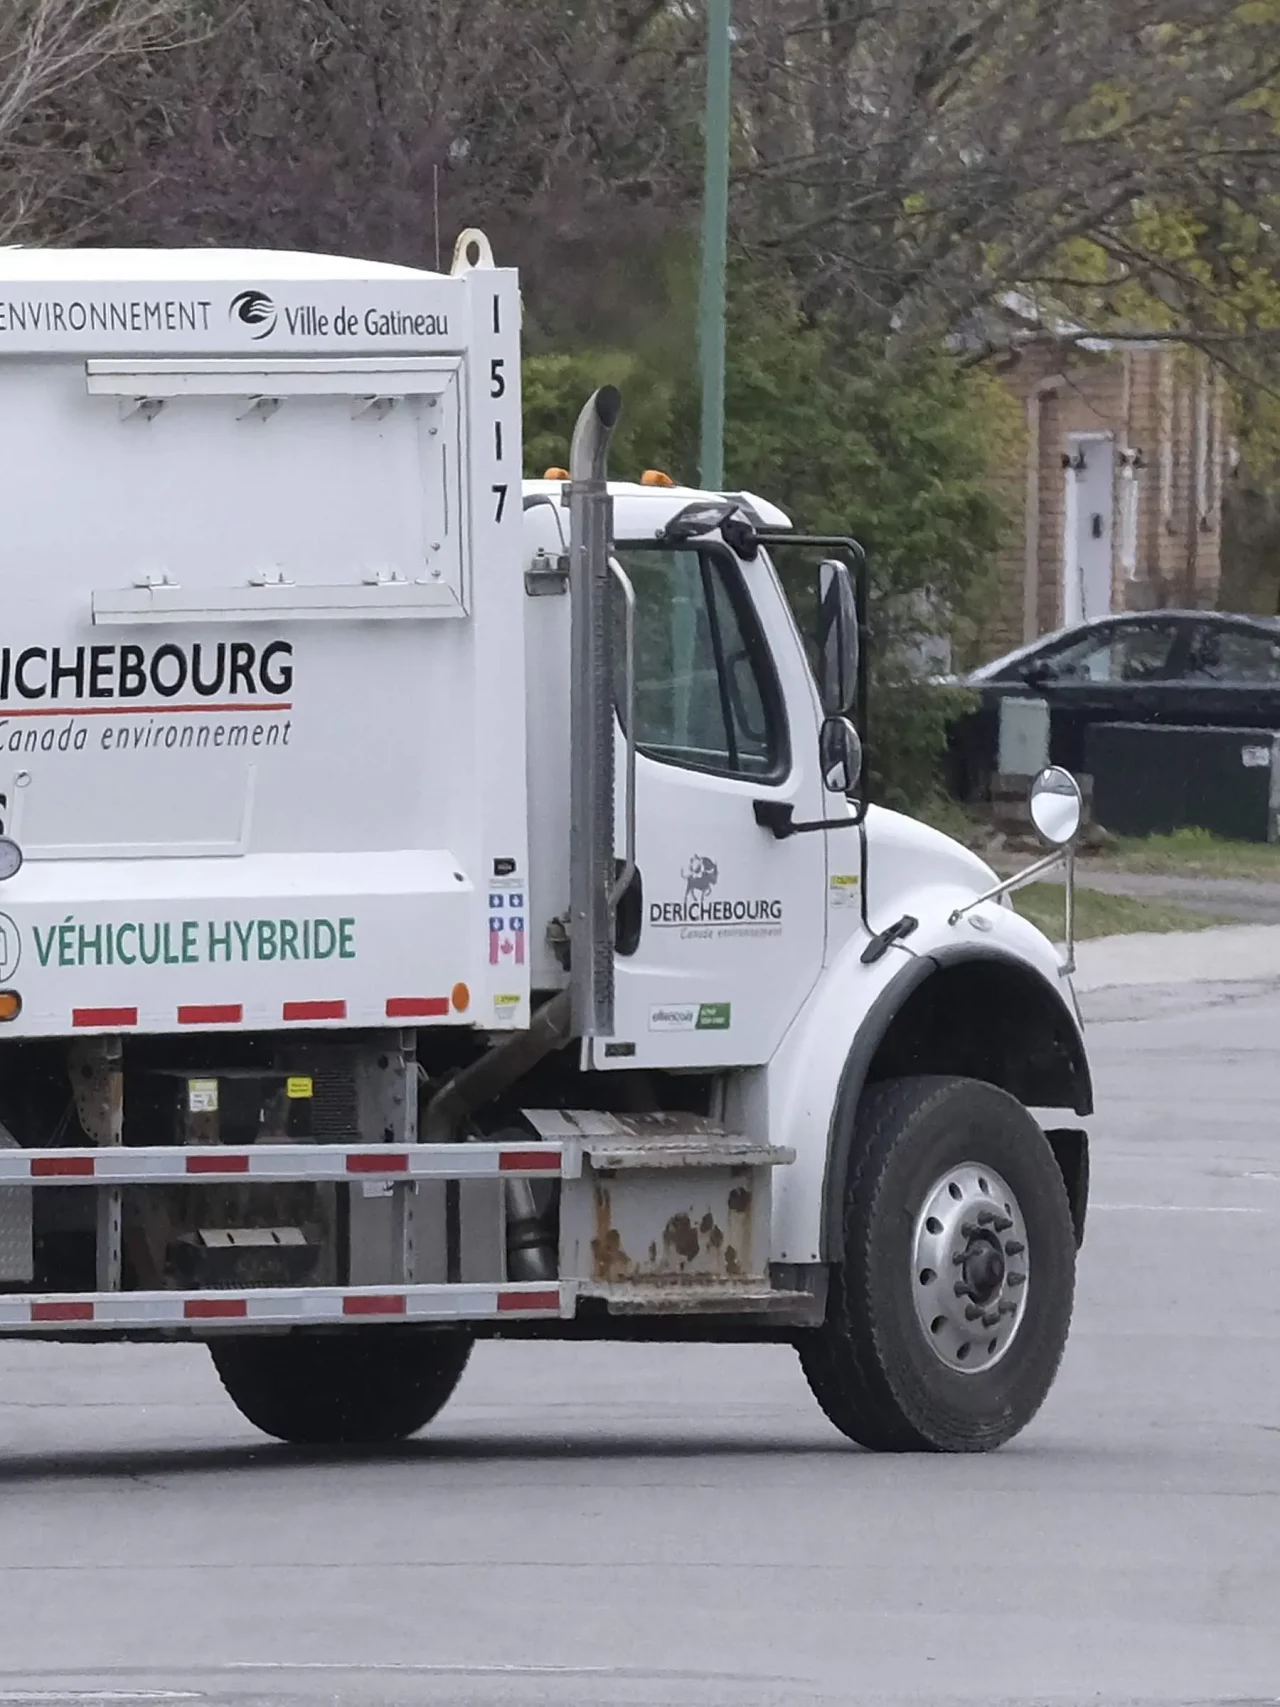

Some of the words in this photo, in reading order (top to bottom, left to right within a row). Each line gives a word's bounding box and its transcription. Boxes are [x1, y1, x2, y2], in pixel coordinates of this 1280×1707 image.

[284, 305, 329, 336] Ville
[333, 305, 359, 336] de
[364, 308, 449, 336] Gatineau
[101, 717, 293, 750] environnement
[649, 900, 783, 922] DERICHEBOURG
[32, 915, 200, 967] VÉHICULE
[208, 918, 357, 962] HYBRIDE
